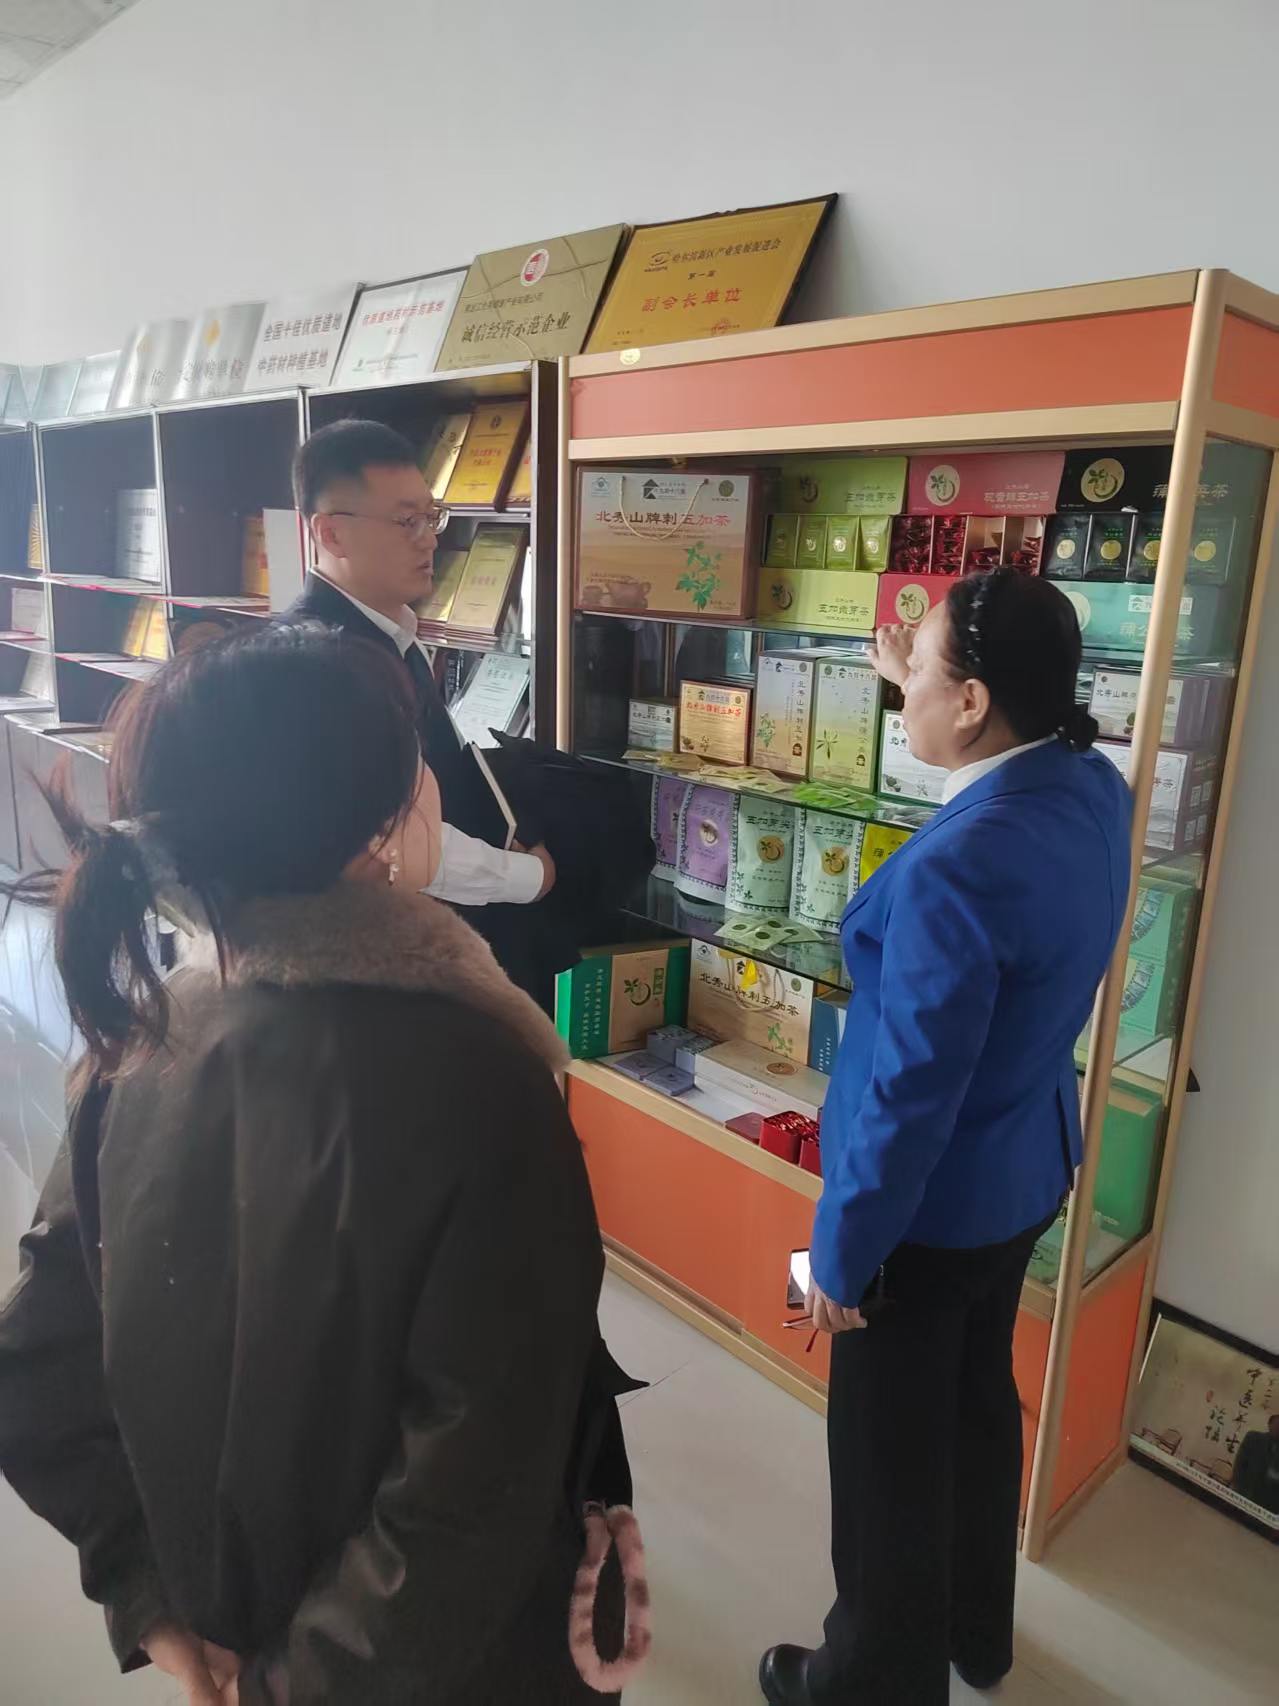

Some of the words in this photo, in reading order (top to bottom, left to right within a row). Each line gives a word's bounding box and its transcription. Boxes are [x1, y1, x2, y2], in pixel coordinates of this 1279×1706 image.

[642, 288, 742, 312] 副会长单位
[461, 312, 570, 342] 诚信经营示范企业
[596, 510, 732, 528] 北秀山牌刺五加茶
